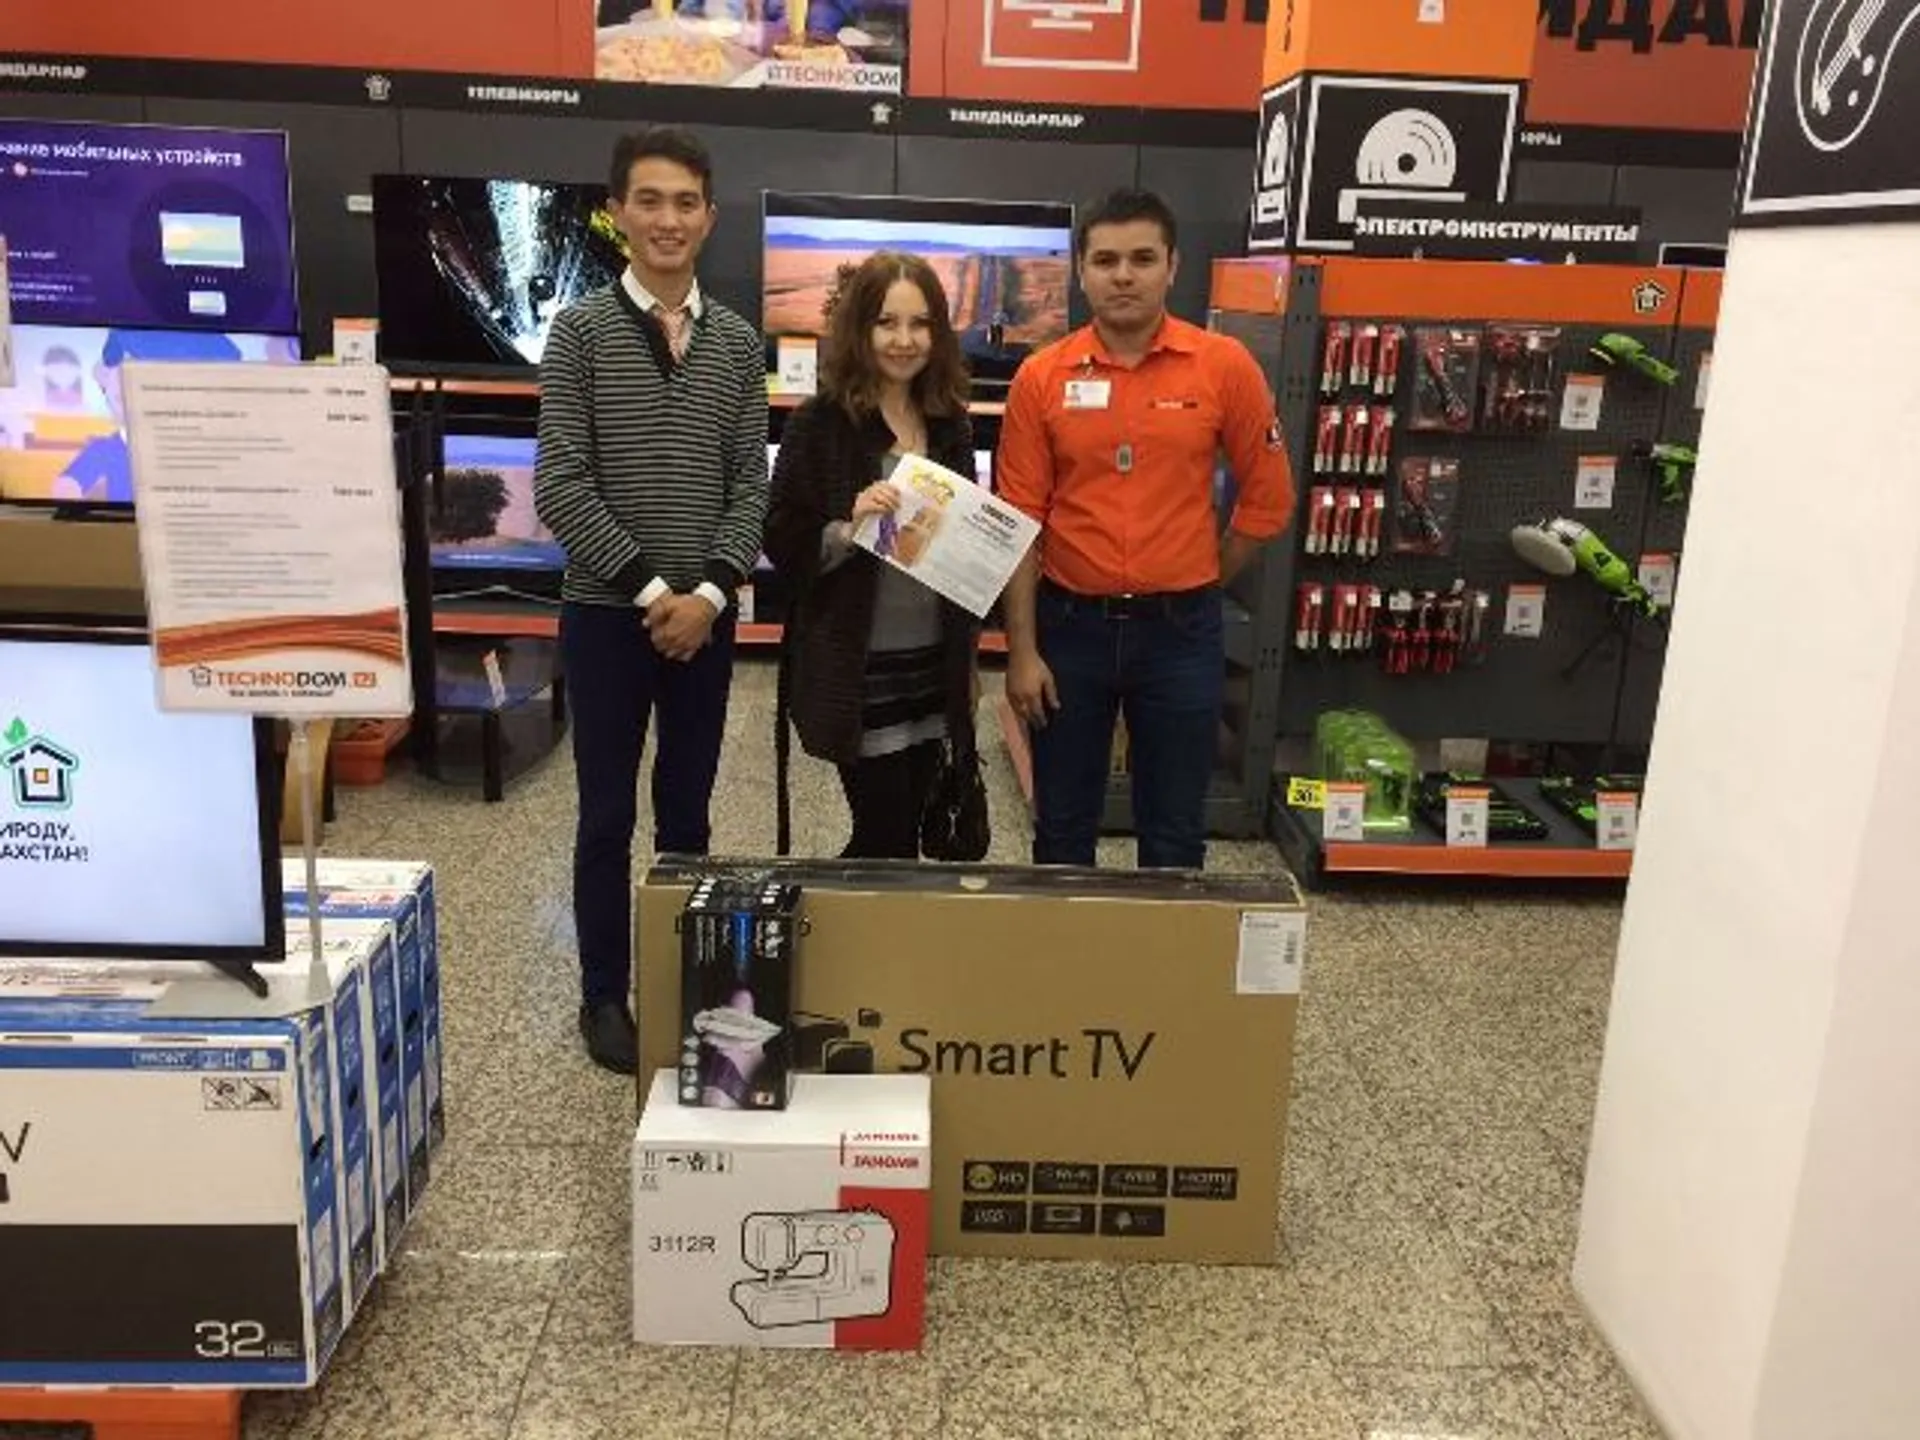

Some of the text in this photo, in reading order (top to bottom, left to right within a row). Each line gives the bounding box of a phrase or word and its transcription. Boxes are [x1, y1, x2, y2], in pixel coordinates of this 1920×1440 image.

[53, 140, 151, 162] мобильных
[155, 147, 243, 166] устройств
[1355, 216, 1640, 242] ЭЛЕКТРОИНСТРУМЕНТЫ
[217, 671, 347, 687] TECHNODOM
[898, 1028, 1156, 1081] Smart TV
[649, 1236, 716, 1252] 3112R
[195, 1320, 265, 1357] 32
